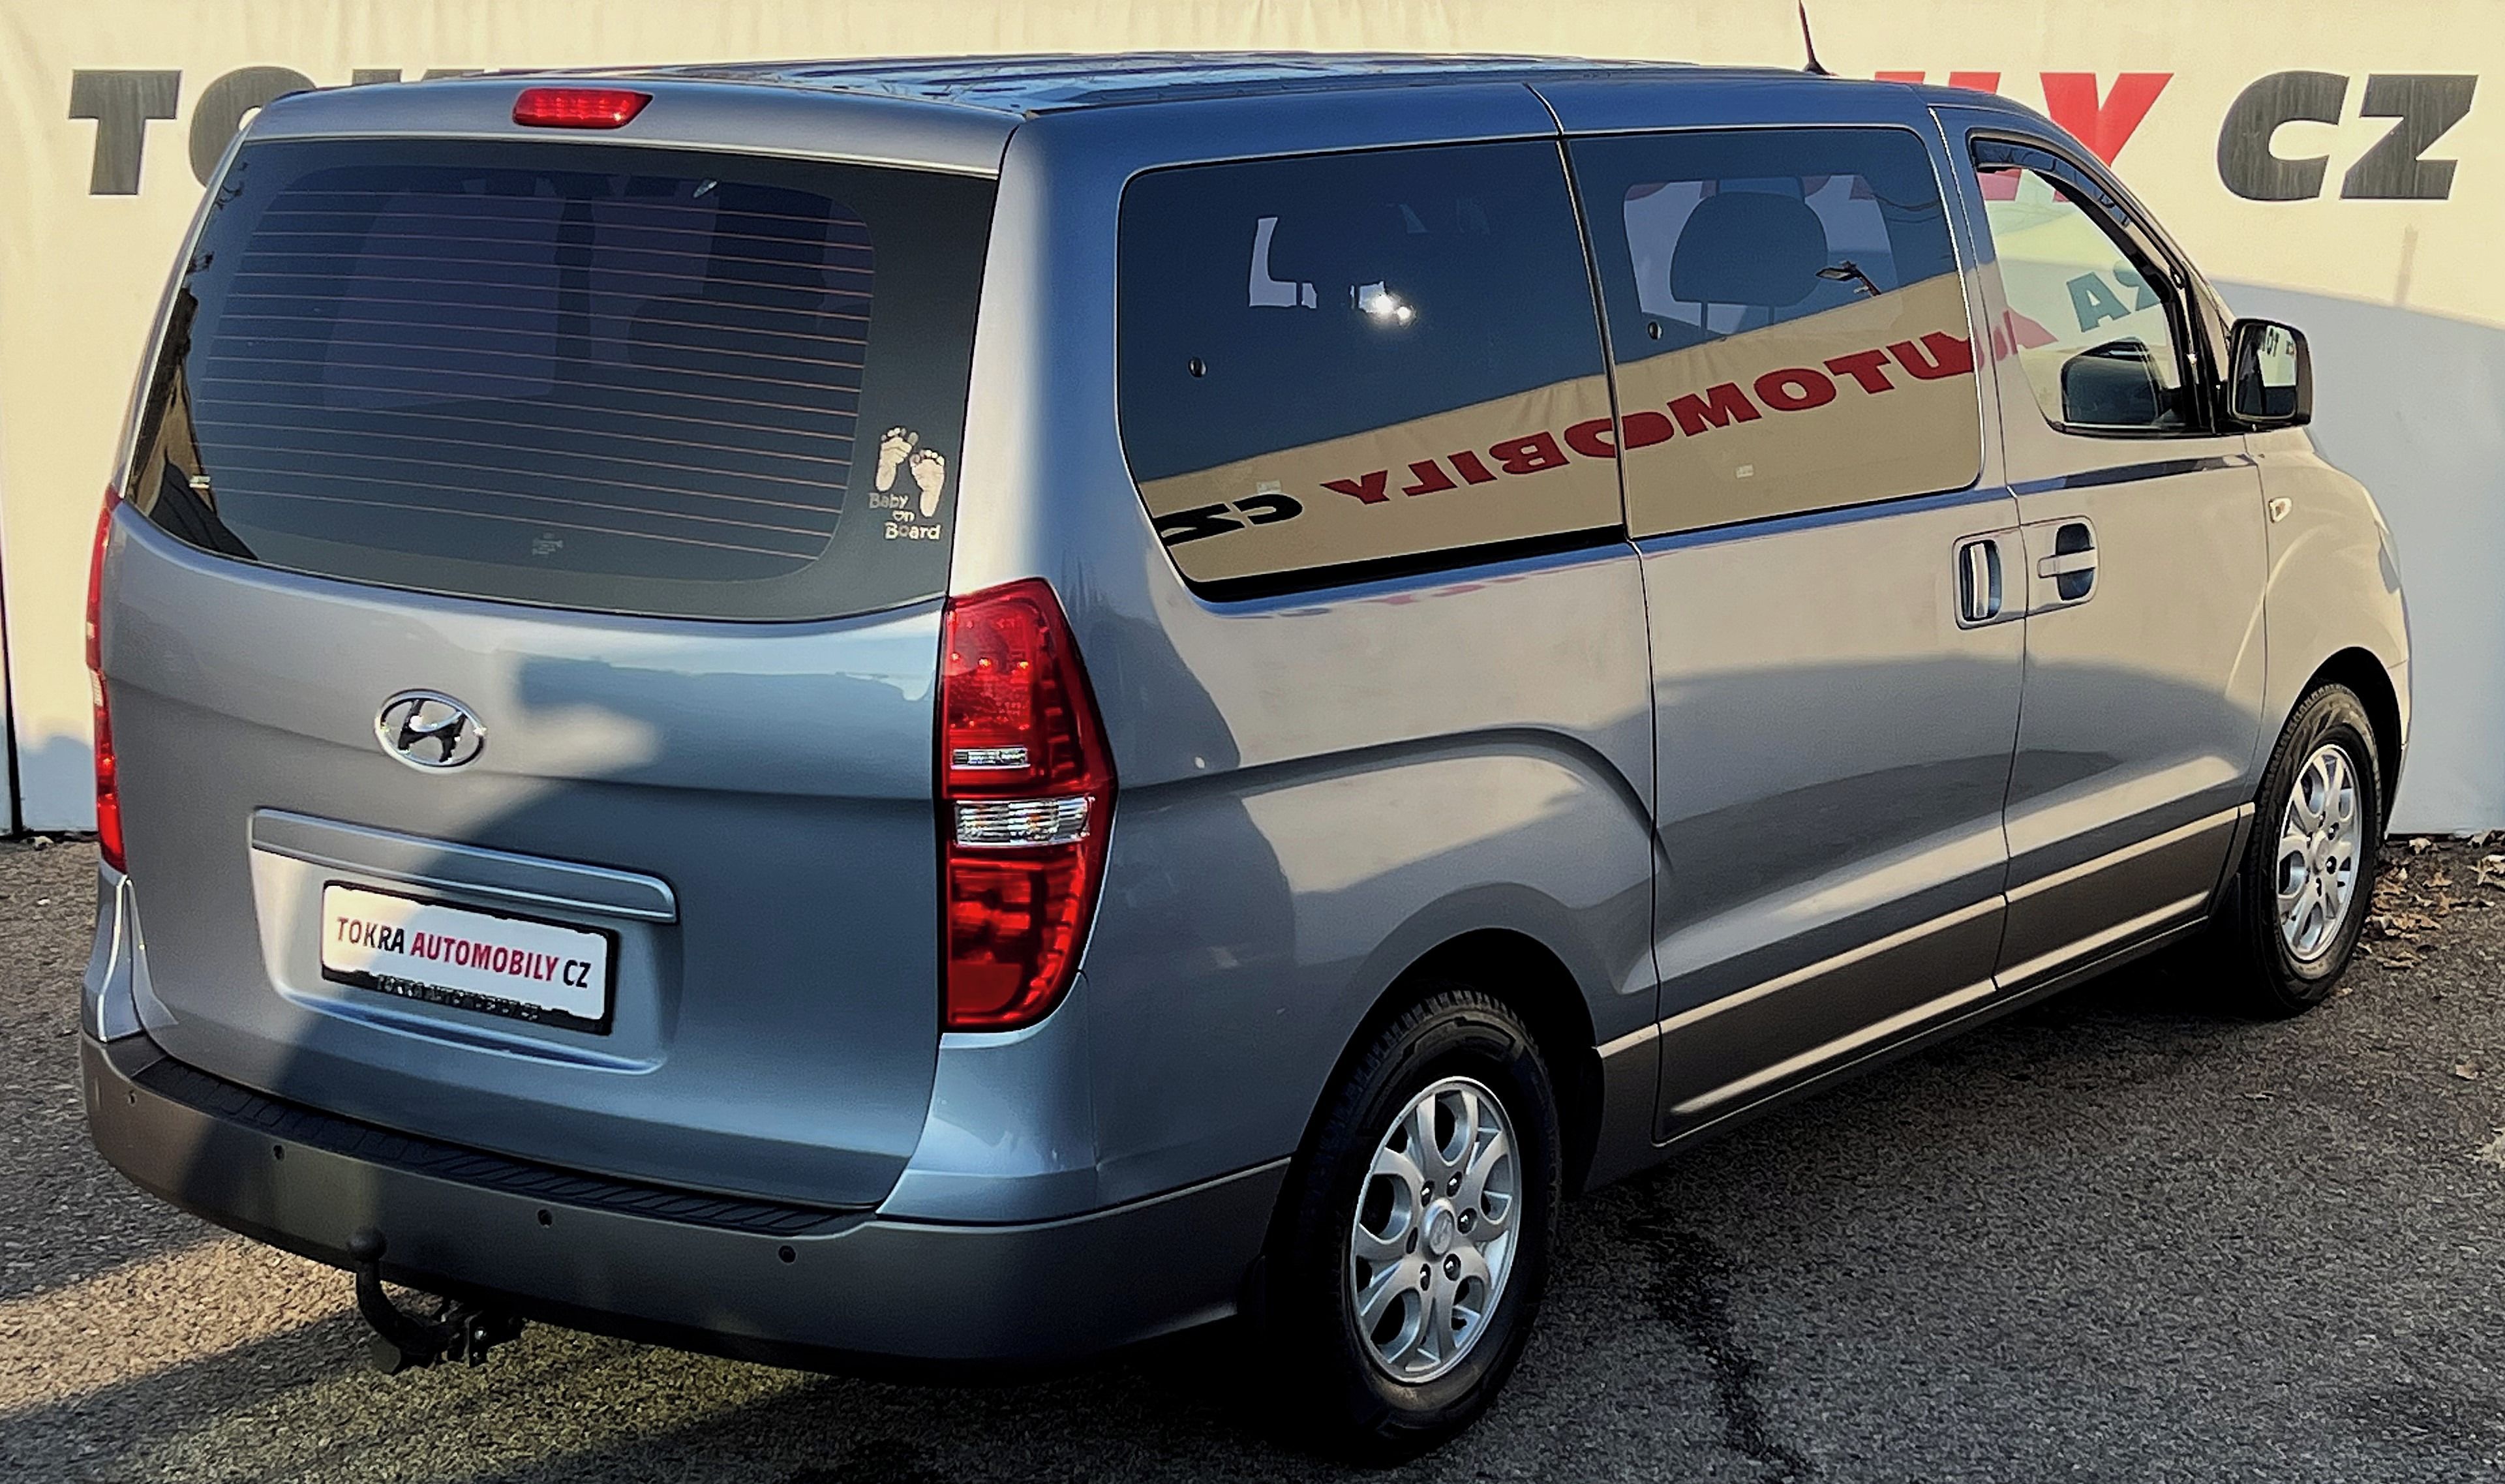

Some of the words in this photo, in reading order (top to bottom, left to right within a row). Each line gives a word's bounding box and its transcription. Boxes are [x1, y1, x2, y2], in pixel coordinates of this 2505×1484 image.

[2217, 70, 2479, 202] CZ
[869, 492, 909, 509] Baby
[892, 510, 915, 522] on
[885, 522, 941, 540] Board
[337, 916, 405, 954] TOKRA
[410, 932, 560, 982] AUTOMOBILY
[562, 960, 592, 988] CZ
